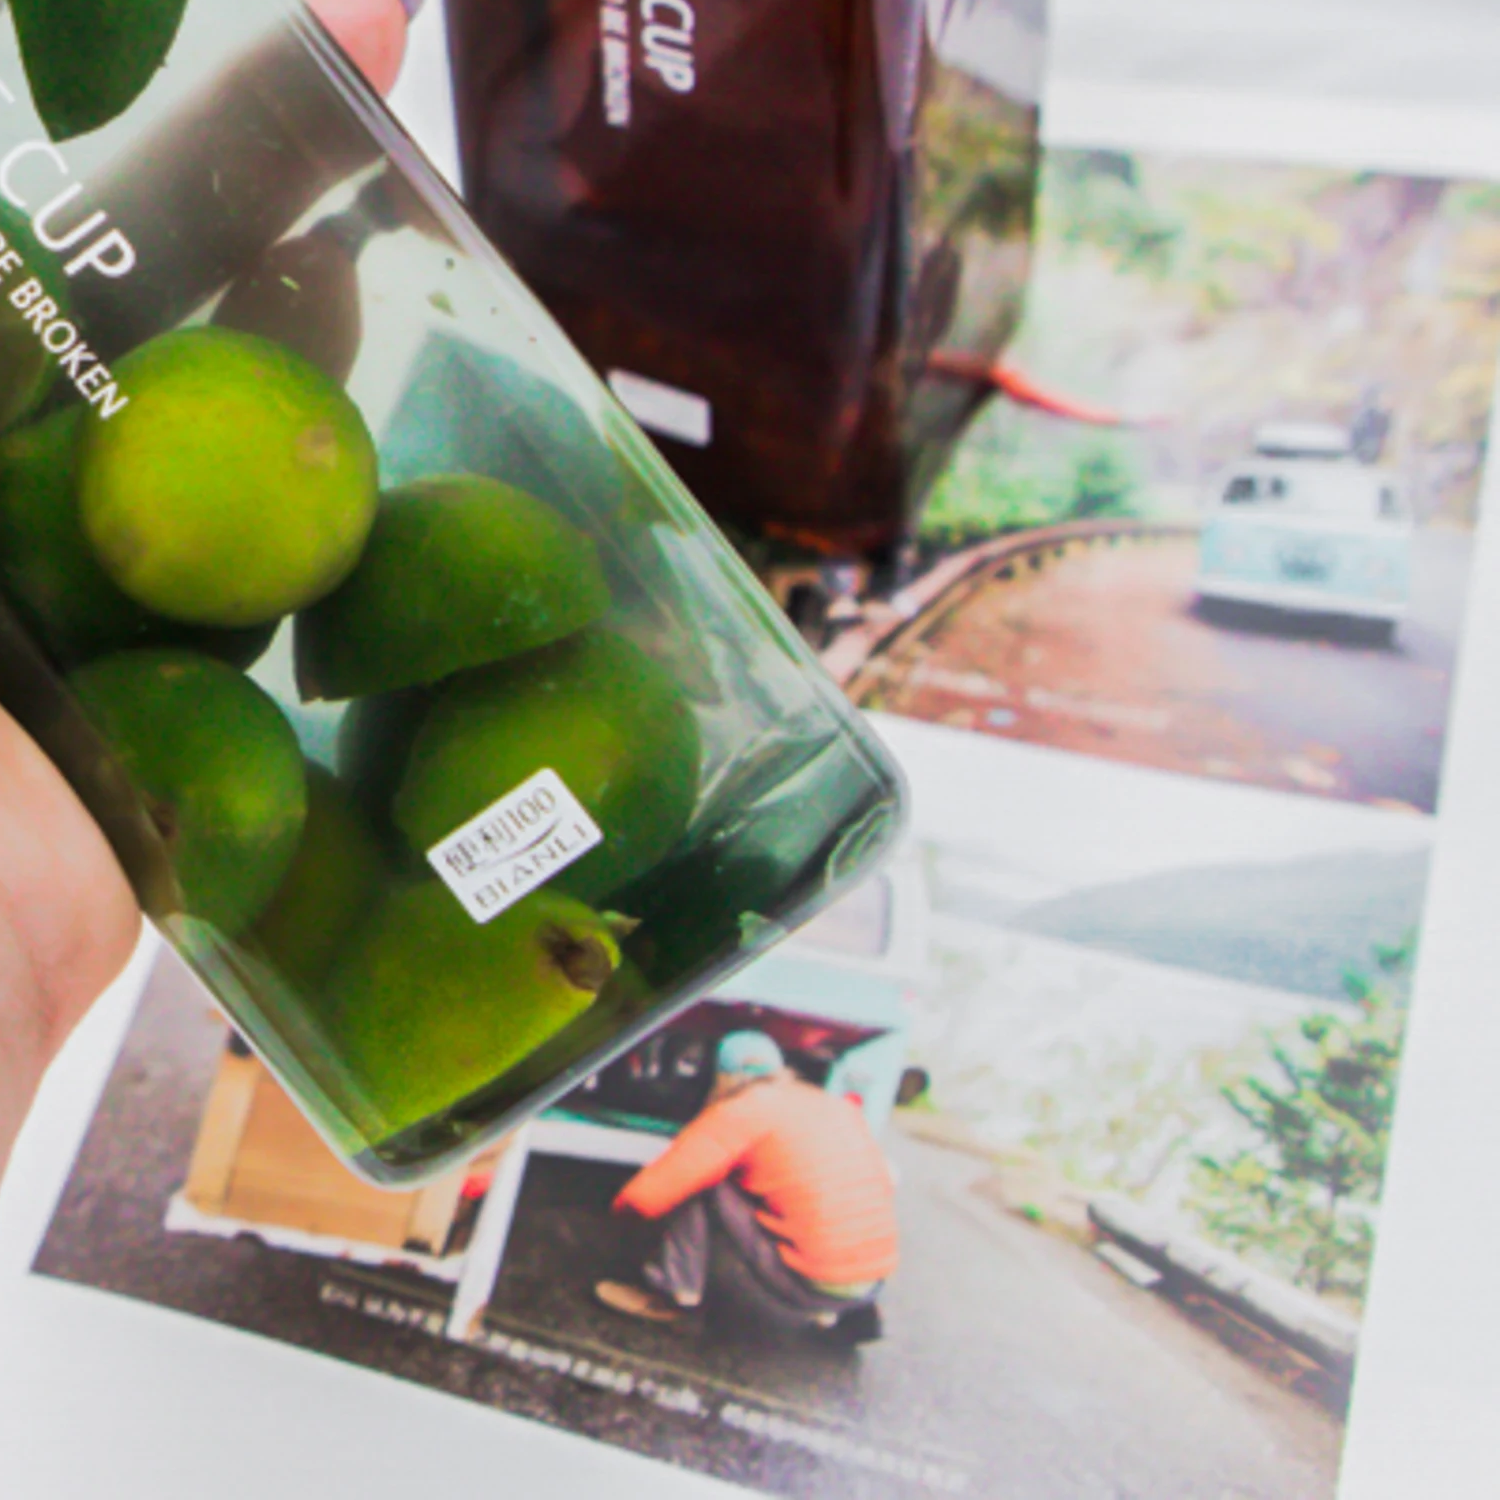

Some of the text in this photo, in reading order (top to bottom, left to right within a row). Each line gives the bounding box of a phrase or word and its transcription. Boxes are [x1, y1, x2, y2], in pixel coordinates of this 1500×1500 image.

[0, 139, 136, 280] CUP
[8, 276, 130, 420] BROKEN
[473, 823, 587, 909] BIANLI
